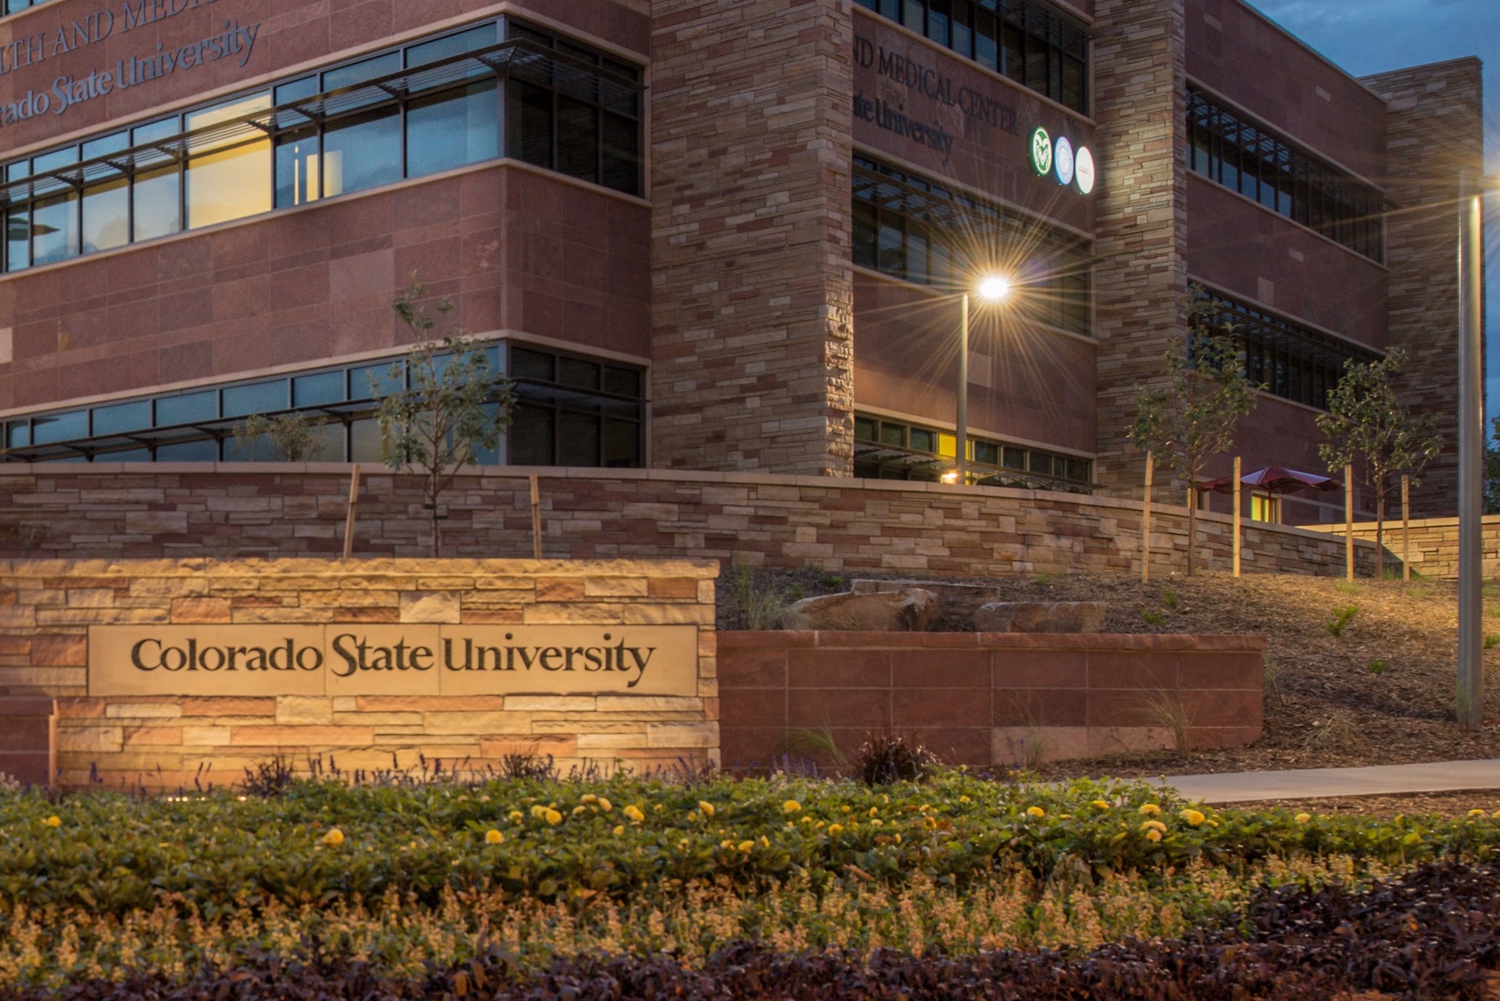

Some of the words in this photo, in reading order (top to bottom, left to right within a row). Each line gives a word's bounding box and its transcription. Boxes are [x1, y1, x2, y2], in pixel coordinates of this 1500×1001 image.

[51, 68, 114, 115] State
[117, 19, 261, 90] University
[52, 9, 114, 57] AND
[878, 45, 955, 108] MEDICAL
[959, 85, 1019, 137] CENTER
[874, 96, 953, 167] University
[131, 637, 323, 672] Colorado
[332, 633, 434, 678] State
[443, 633, 658, 688] University
